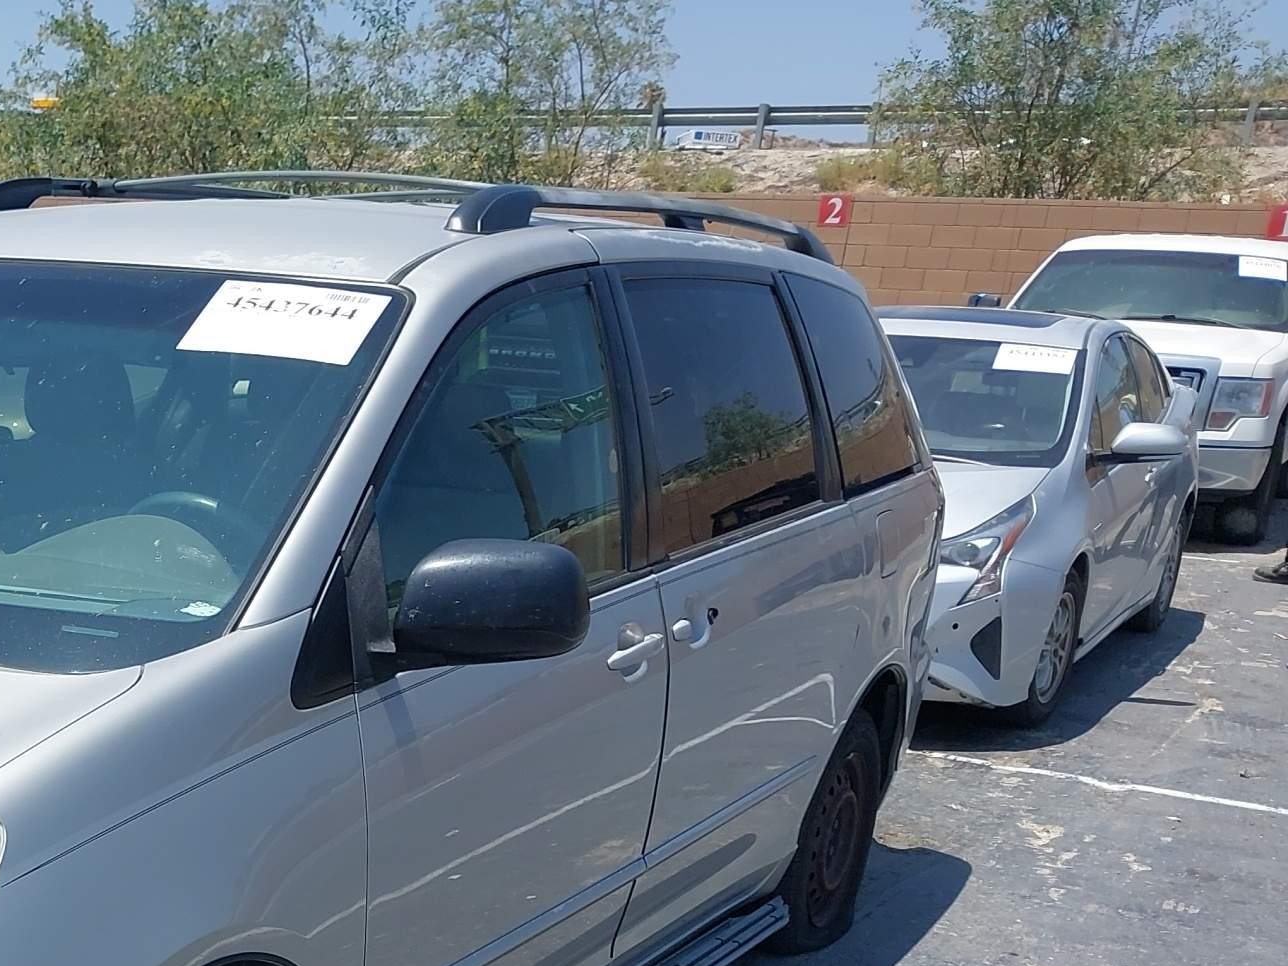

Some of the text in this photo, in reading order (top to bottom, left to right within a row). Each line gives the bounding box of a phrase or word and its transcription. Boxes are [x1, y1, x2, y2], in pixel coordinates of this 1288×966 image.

[703, 132, 738, 143] INTERTEX
[824, 197, 842, 224] 2
[226, 296, 358, 319] 45437644
